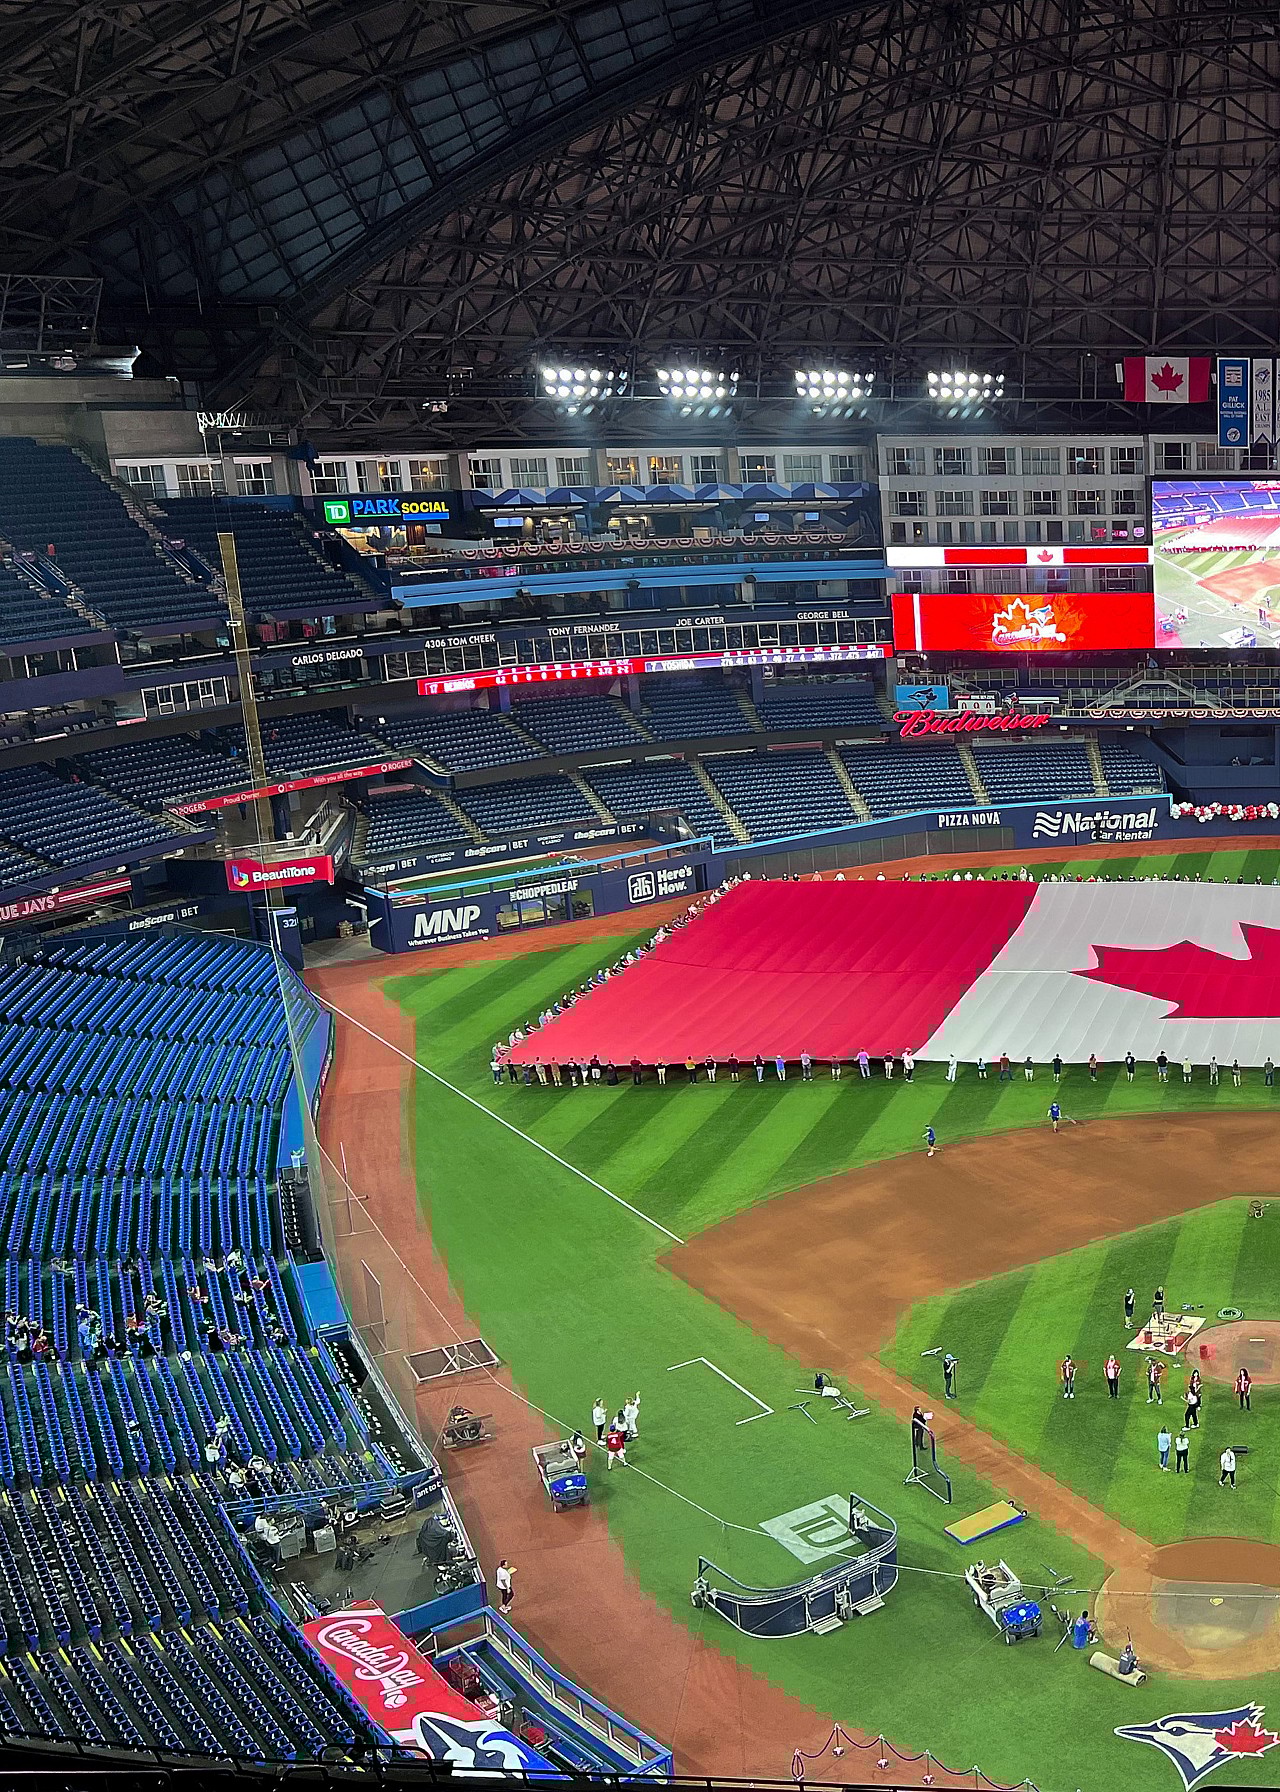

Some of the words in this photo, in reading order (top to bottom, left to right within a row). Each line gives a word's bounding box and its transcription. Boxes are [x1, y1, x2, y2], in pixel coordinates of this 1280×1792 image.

[1255, 389, 1270, 401] 1985
[1255, 414, 1271, 422] EAST
[326, 505, 347, 520] TD
[353, 499, 400, 514] PARK
[402, 502, 449, 514] SOCIAL
[676, 618, 692, 626] JOE
[695, 616, 725, 625] CARTER
[797, 612, 829, 620] GEORGE
[832, 611, 849, 619] BELL
[547, 627, 570, 636] TONY
[574, 623, 620, 634] FERNANDEZ
[425, 639, 446, 649] 4306
[447, 637, 467, 647] TOM
[469, 634, 495, 645] CHEEK
[292, 654, 323, 666] CARLOS
[326, 649, 363, 662] DELGADO
[893, 709, 1050, 737] Budweiser
[223, 797, 240, 805] Proud
[313, 776, 327, 784] With
[327, 776, 337, 784] you
[344, 771, 352, 779] the
[388, 759, 412, 771] ROGERS
[938, 813, 969, 828] PIZZA
[972, 812, 1001, 826] NOVA
[574, 828, 615, 840] theScore
[621, 824, 637, 834] BET
[1091, 830, 1113, 840] Car
[1115, 830, 1152, 840] Rental
[465, 844, 507, 858] theScore
[513, 839, 529, 850] BET
[401, 857, 417, 869] BET
[252, 866, 316, 882] BeautiTone
[657, 865, 693, 883] Here's
[658, 881, 688, 896] How.
[0, 905, 19, 921] UE
[21, 895, 55, 915] JAYS
[129, 912, 174, 930] theScore
[181, 906, 199, 918] BET
[414, 905, 481, 938] MNP
[408, 936, 437, 947] Wherever
[438, 933, 462, 942] Business
[462, 929, 478, 938] Takes
[478, 928, 489, 937] You
[317, 1619, 394, 1676] Canada
[354, 1651, 425, 1696] Day
